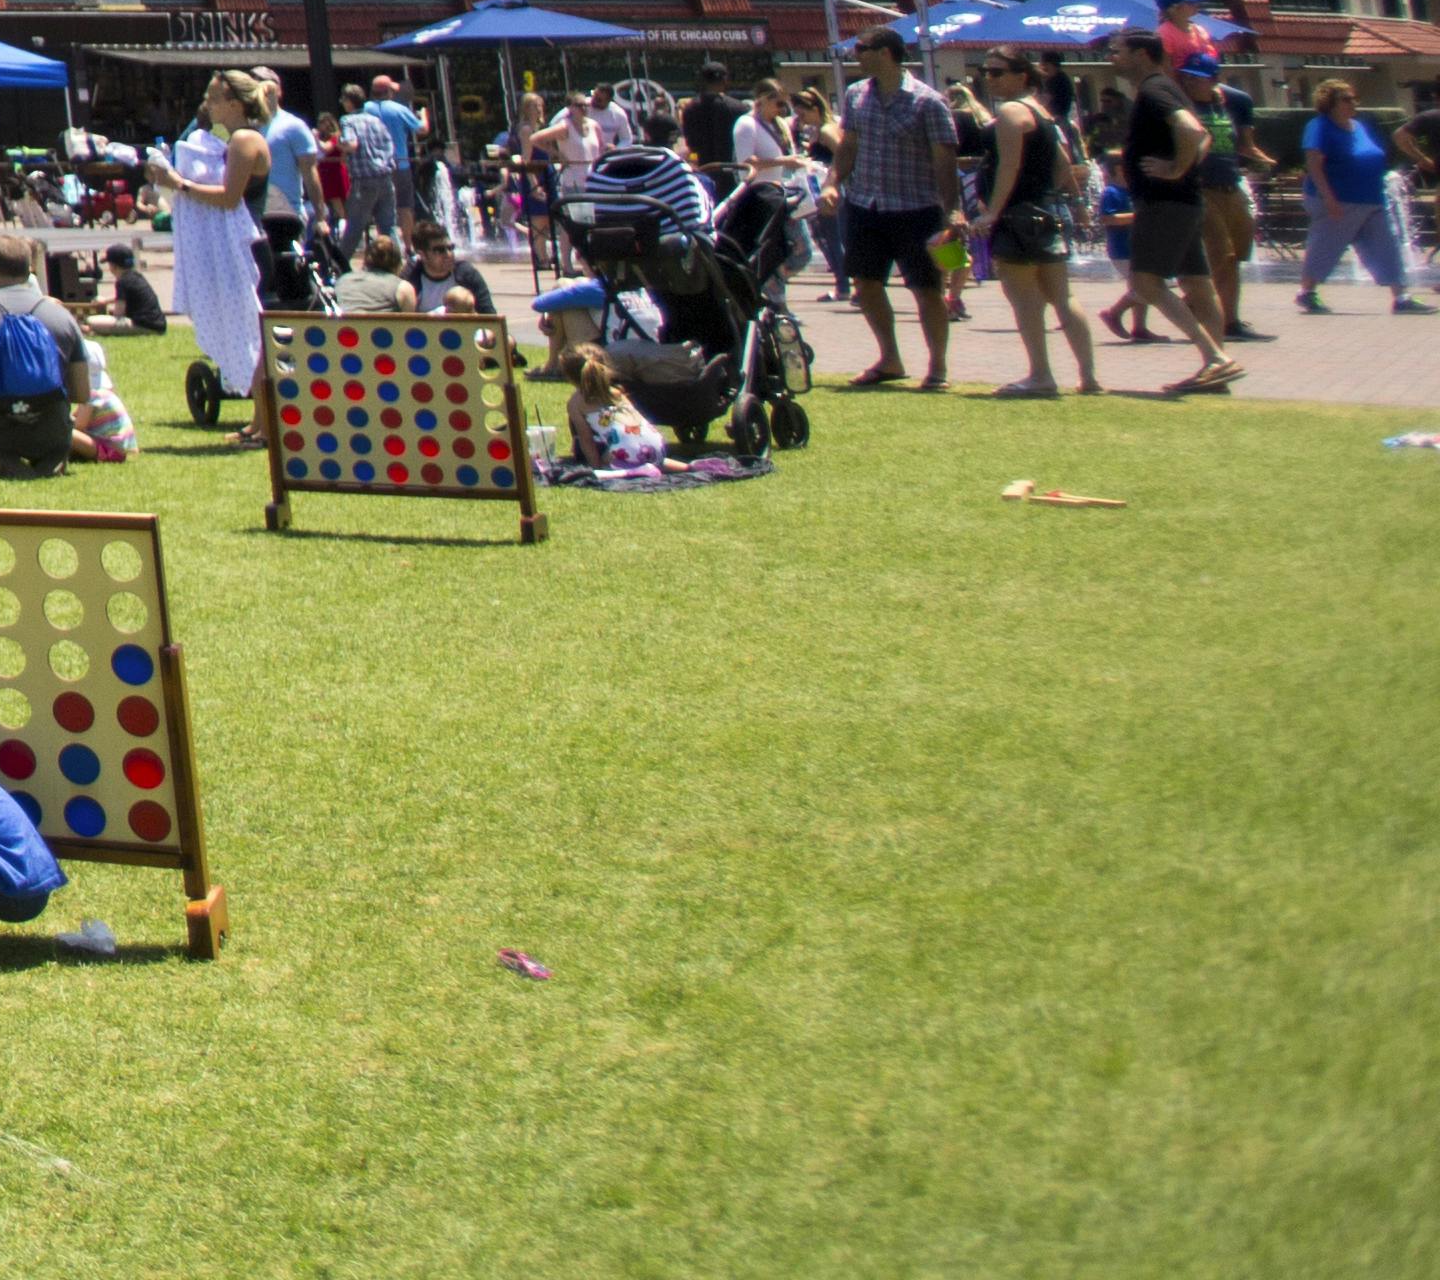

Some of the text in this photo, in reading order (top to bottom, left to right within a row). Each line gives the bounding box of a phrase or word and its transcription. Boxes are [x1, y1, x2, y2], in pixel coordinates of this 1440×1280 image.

[168, 12, 276, 43] DRINKS
[661, 30, 679, 41] THE
[680, 30, 721, 41] CHICAGO
[722, 30, 748, 41] CUBS
